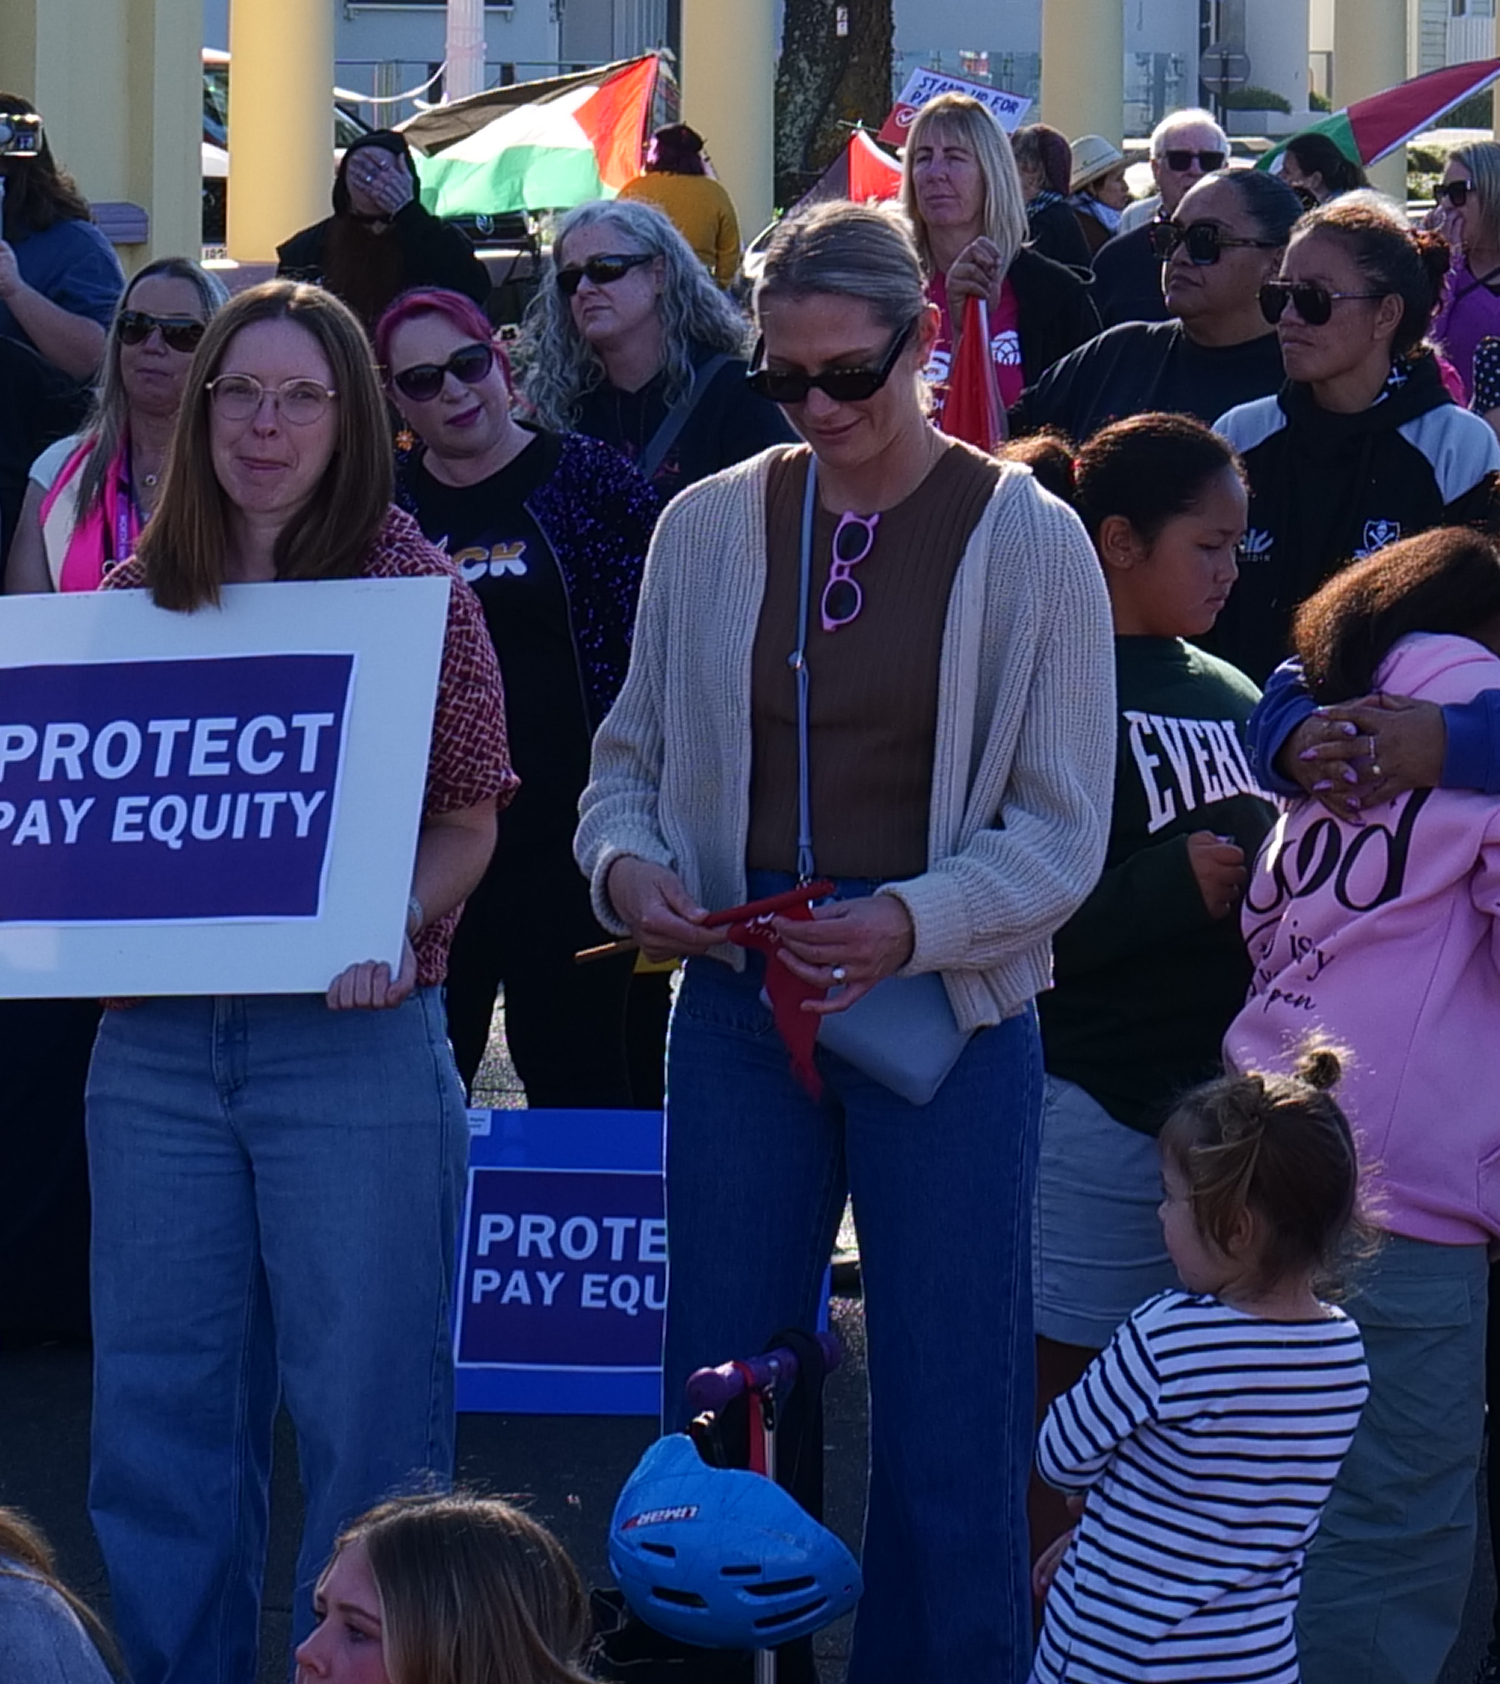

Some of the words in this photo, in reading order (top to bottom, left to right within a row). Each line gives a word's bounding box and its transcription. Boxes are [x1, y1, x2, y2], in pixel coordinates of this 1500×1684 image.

[990, 95, 1020, 116] FOR
[110, 790, 327, 850] EQUITY
[476, 1213, 668, 1263] PROTE
[471, 1268, 566, 1307] PAY
[580, 1273, 668, 1316] EQU
